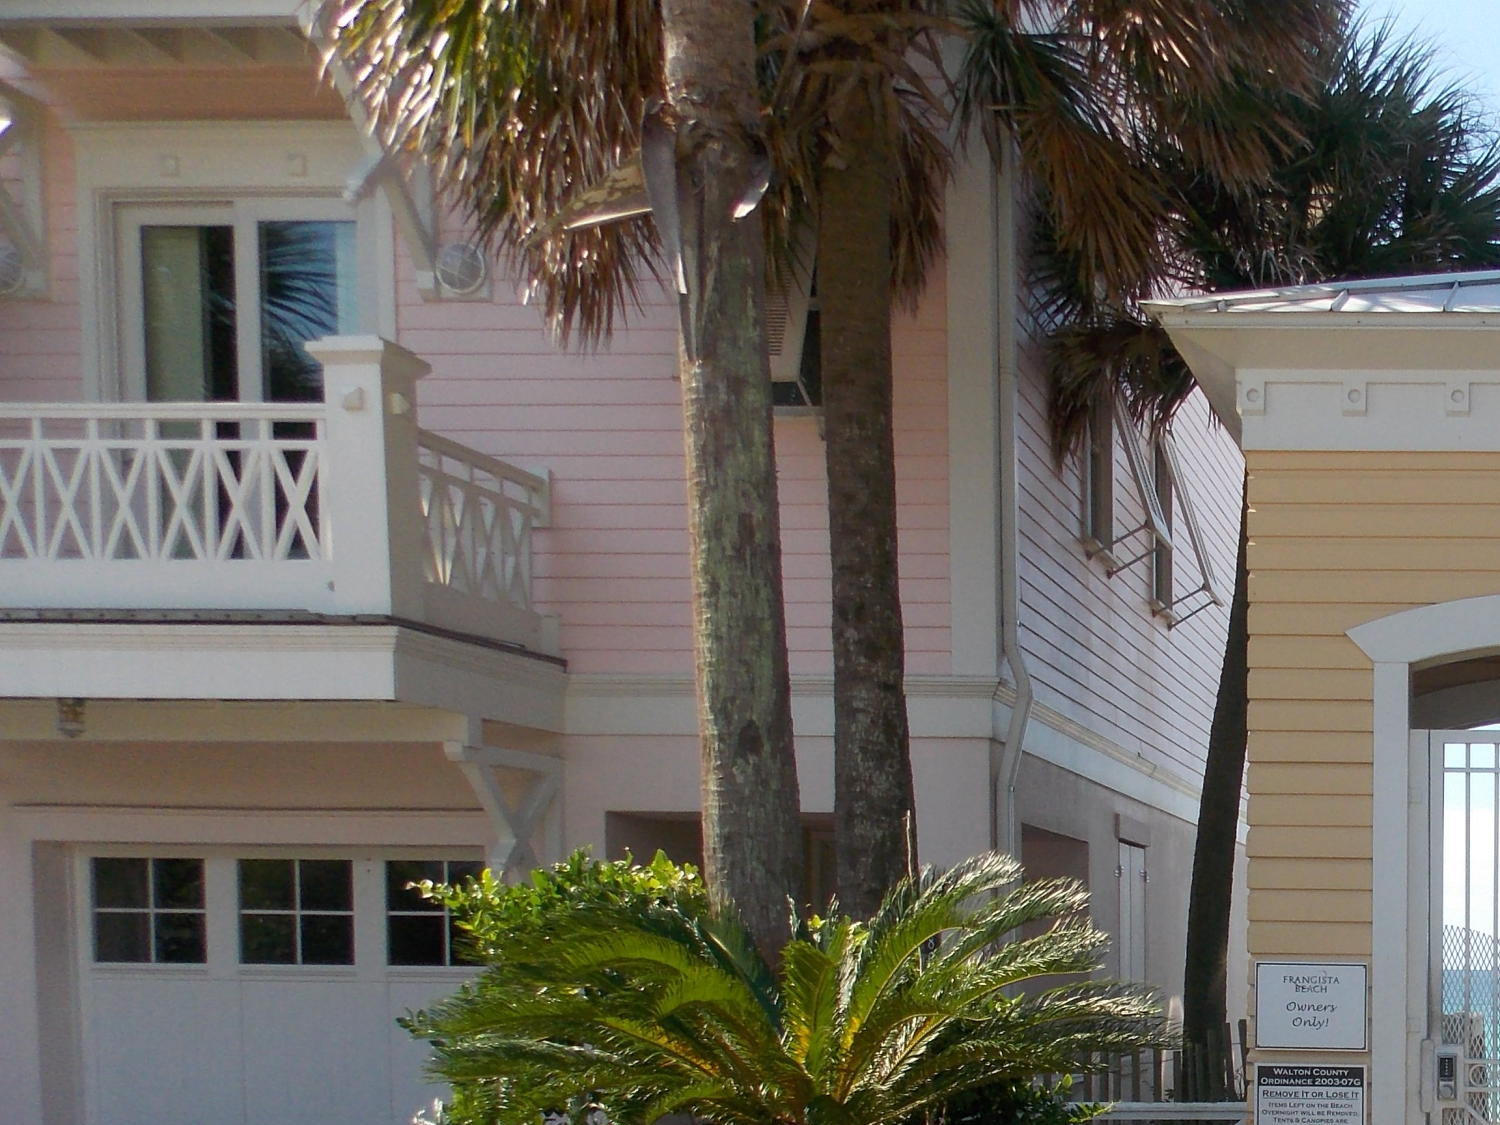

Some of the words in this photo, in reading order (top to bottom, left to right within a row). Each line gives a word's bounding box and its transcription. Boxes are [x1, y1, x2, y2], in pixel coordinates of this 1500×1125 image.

[1283, 975, 1340, 985] FRANGISTA
[1295, 985, 1328, 993] BEACH
[1286, 1001, 1337, 1012] Owners
[1292, 1016, 1329, 1031] Only!
[1314, 1078, 1361, 1086] 2003-07G
